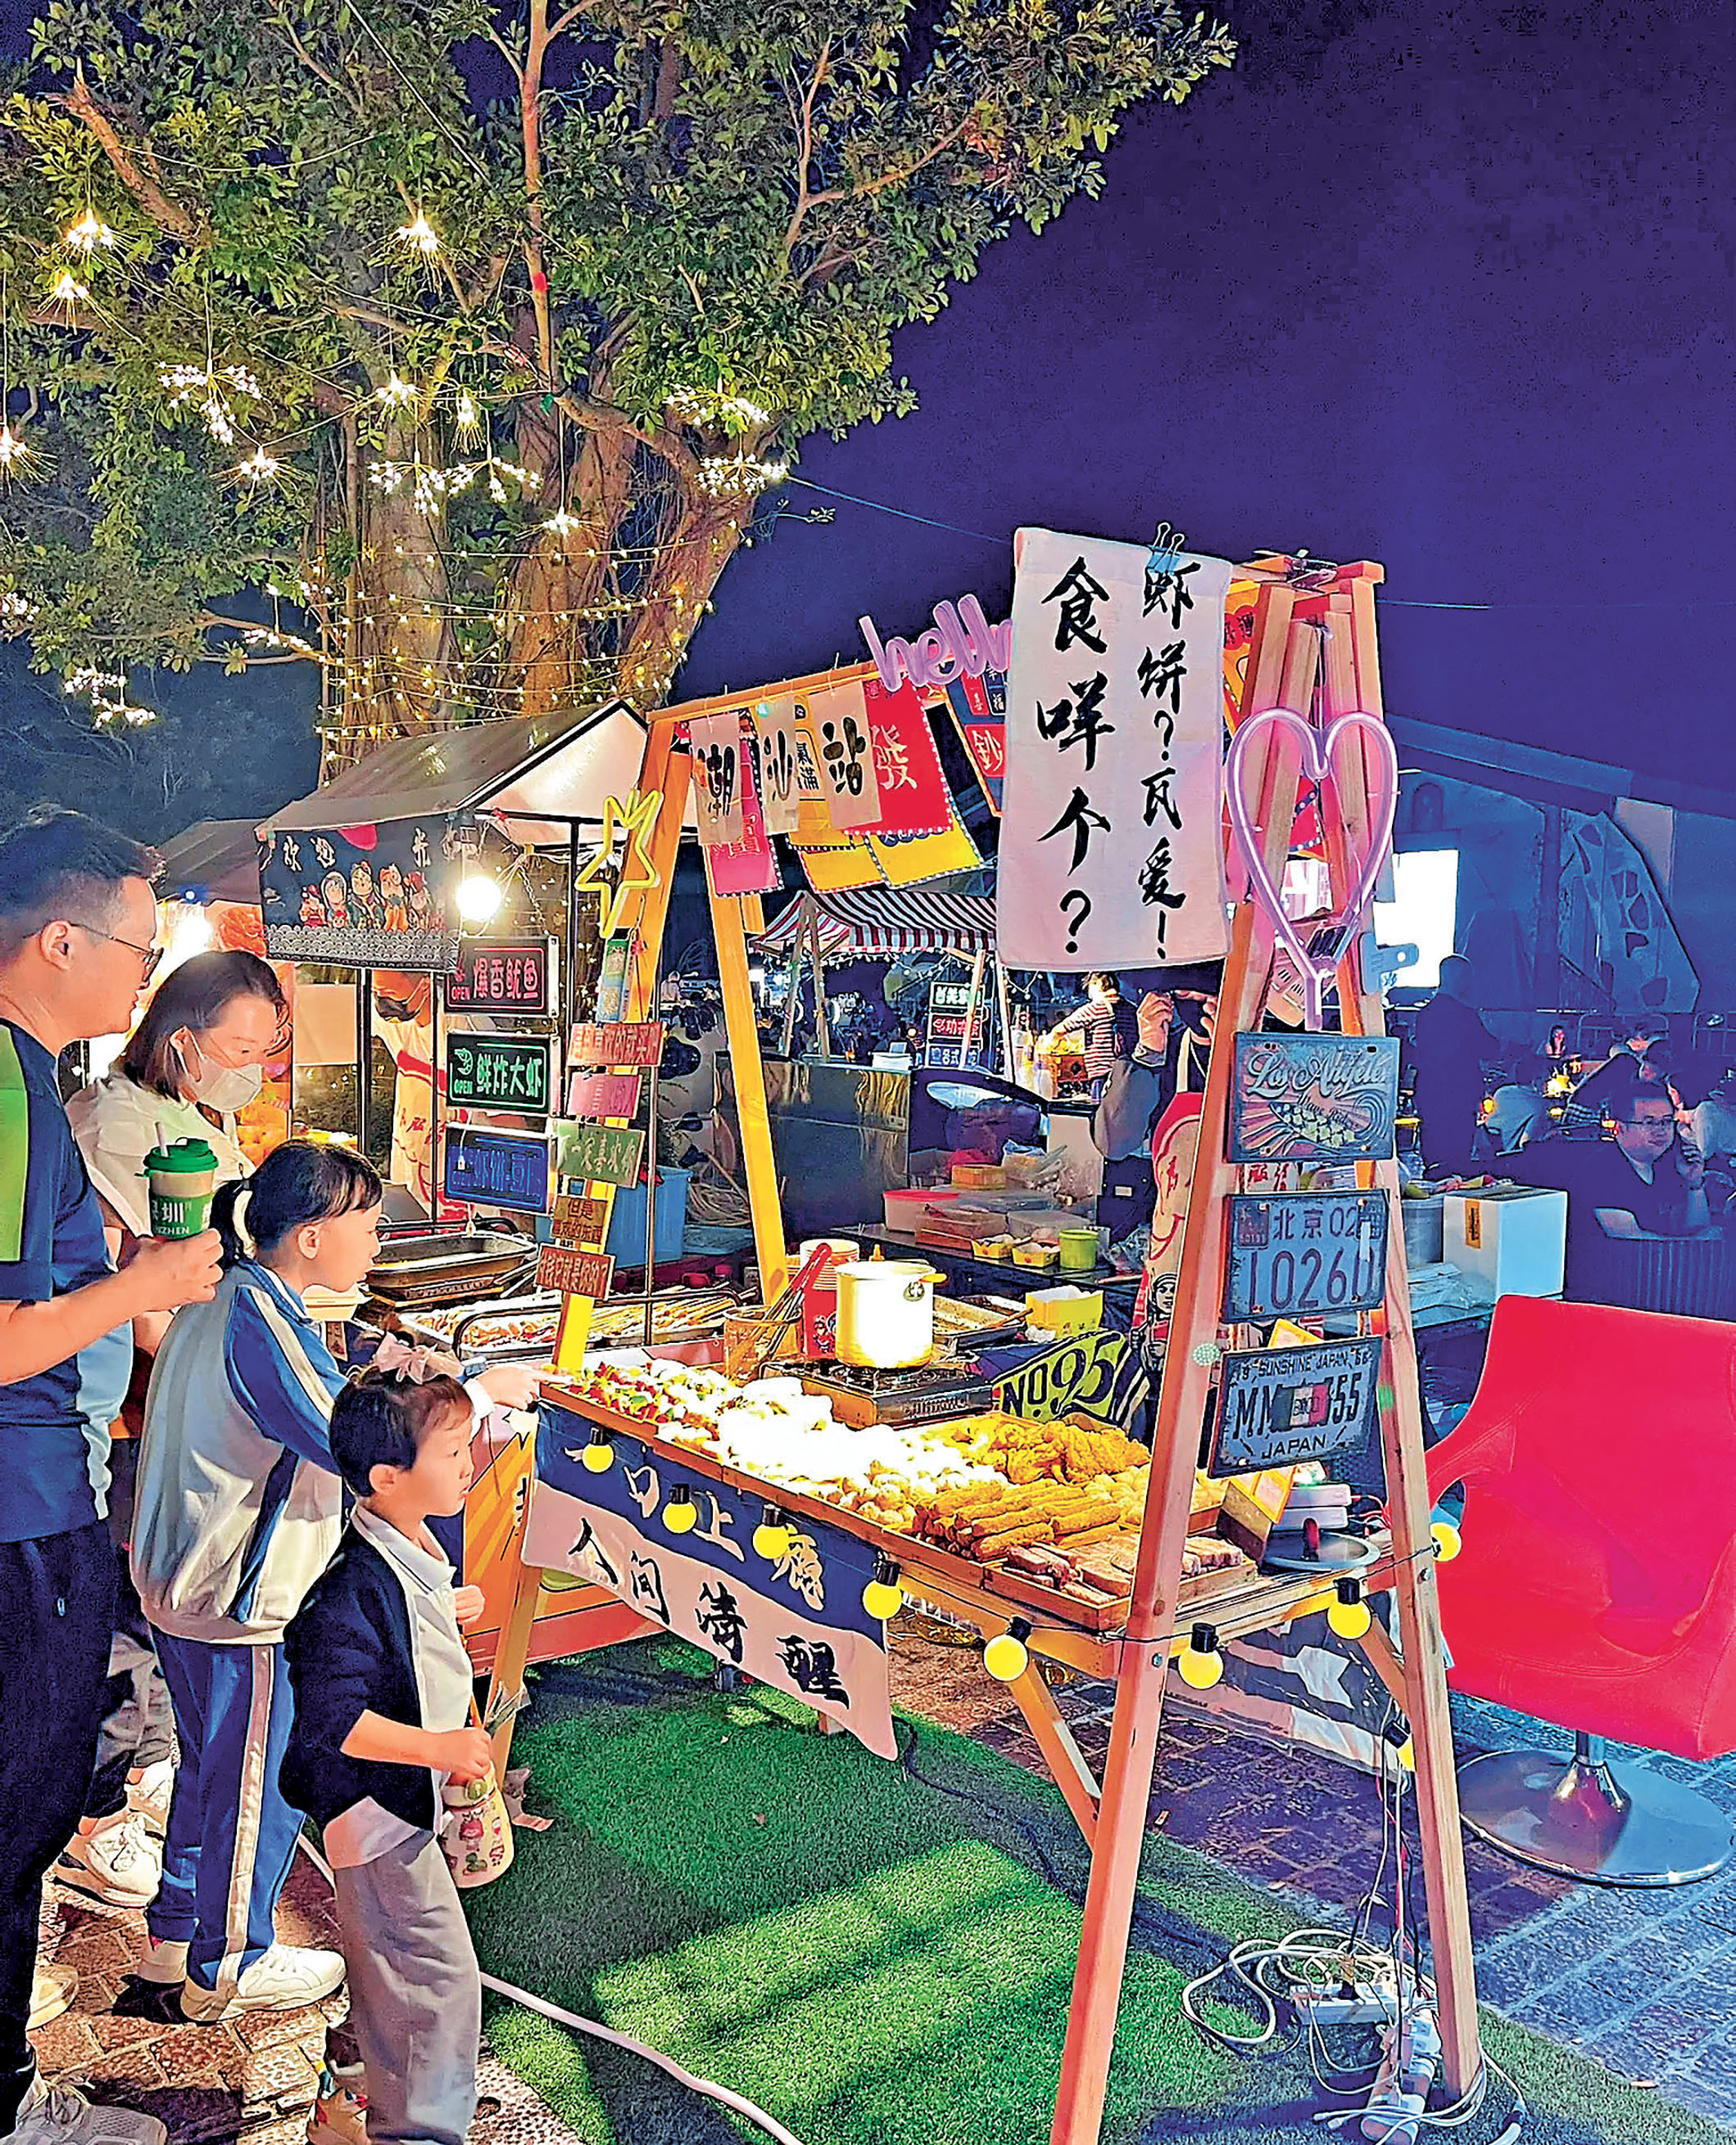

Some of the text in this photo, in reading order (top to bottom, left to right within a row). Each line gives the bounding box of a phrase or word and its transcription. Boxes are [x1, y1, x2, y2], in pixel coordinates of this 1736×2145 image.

[454, 1079, 473, 1095] OPEN
[476, 1053, 543, 1097] 鲜炸大虾
[1246, 1051, 1290, 1099] Los
[1262, 1434, 1326, 1458] JAPAN
